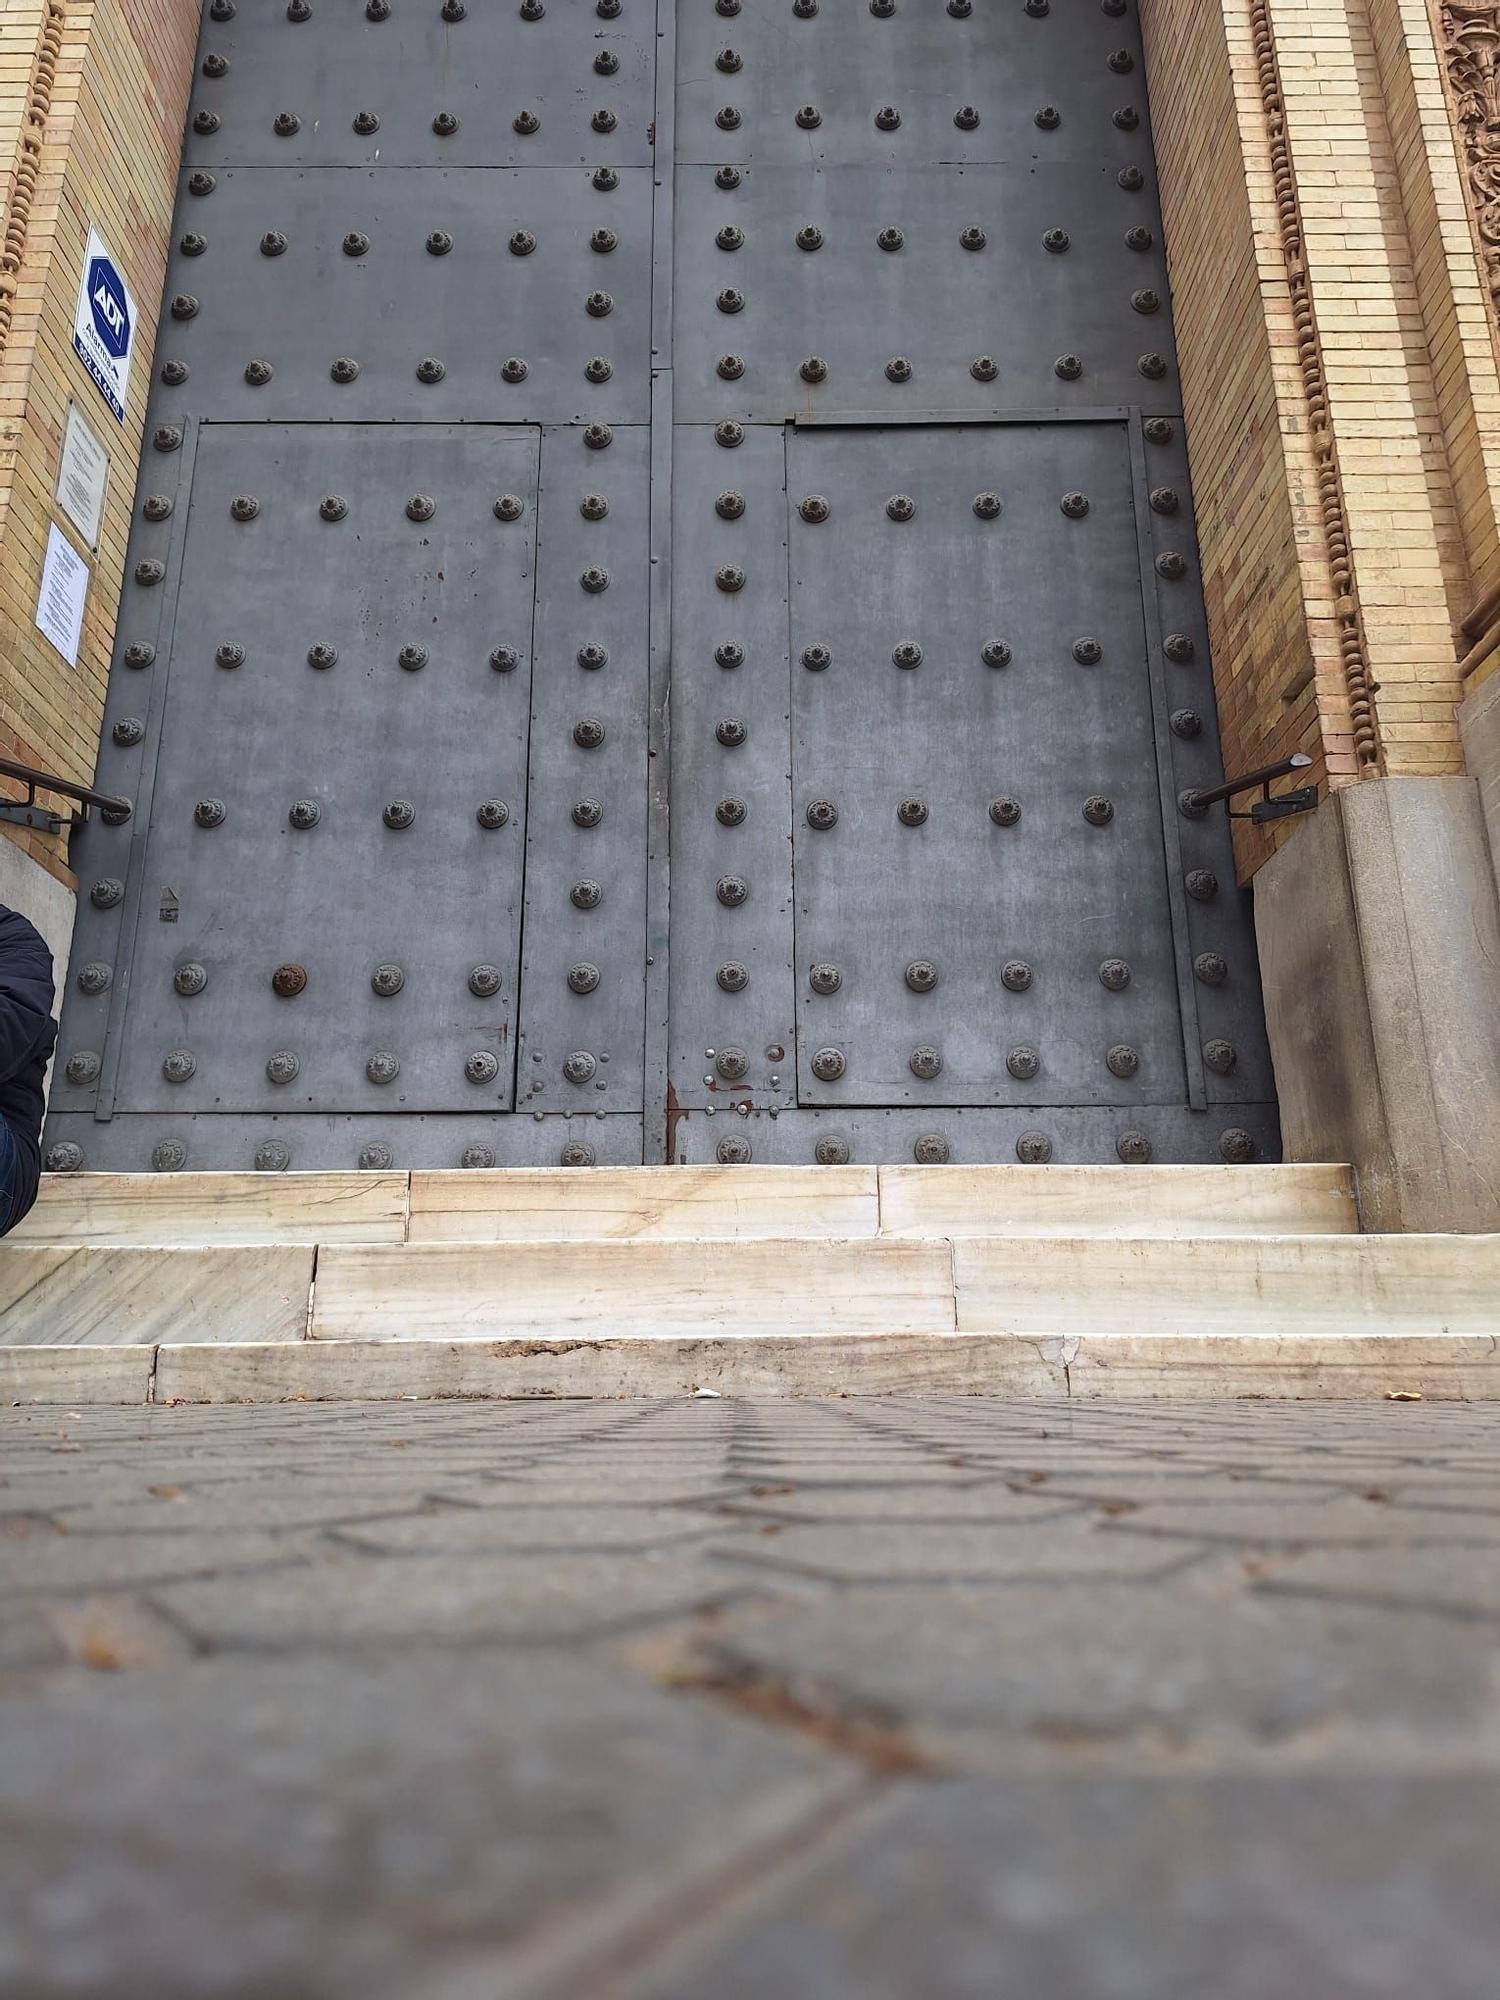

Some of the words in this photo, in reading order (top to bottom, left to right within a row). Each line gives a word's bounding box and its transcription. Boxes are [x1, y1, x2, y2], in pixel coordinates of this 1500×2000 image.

[93, 285, 125, 337] ADT
[79, 342, 92, 369] 902
[85, 323, 112, 368] Alarma
